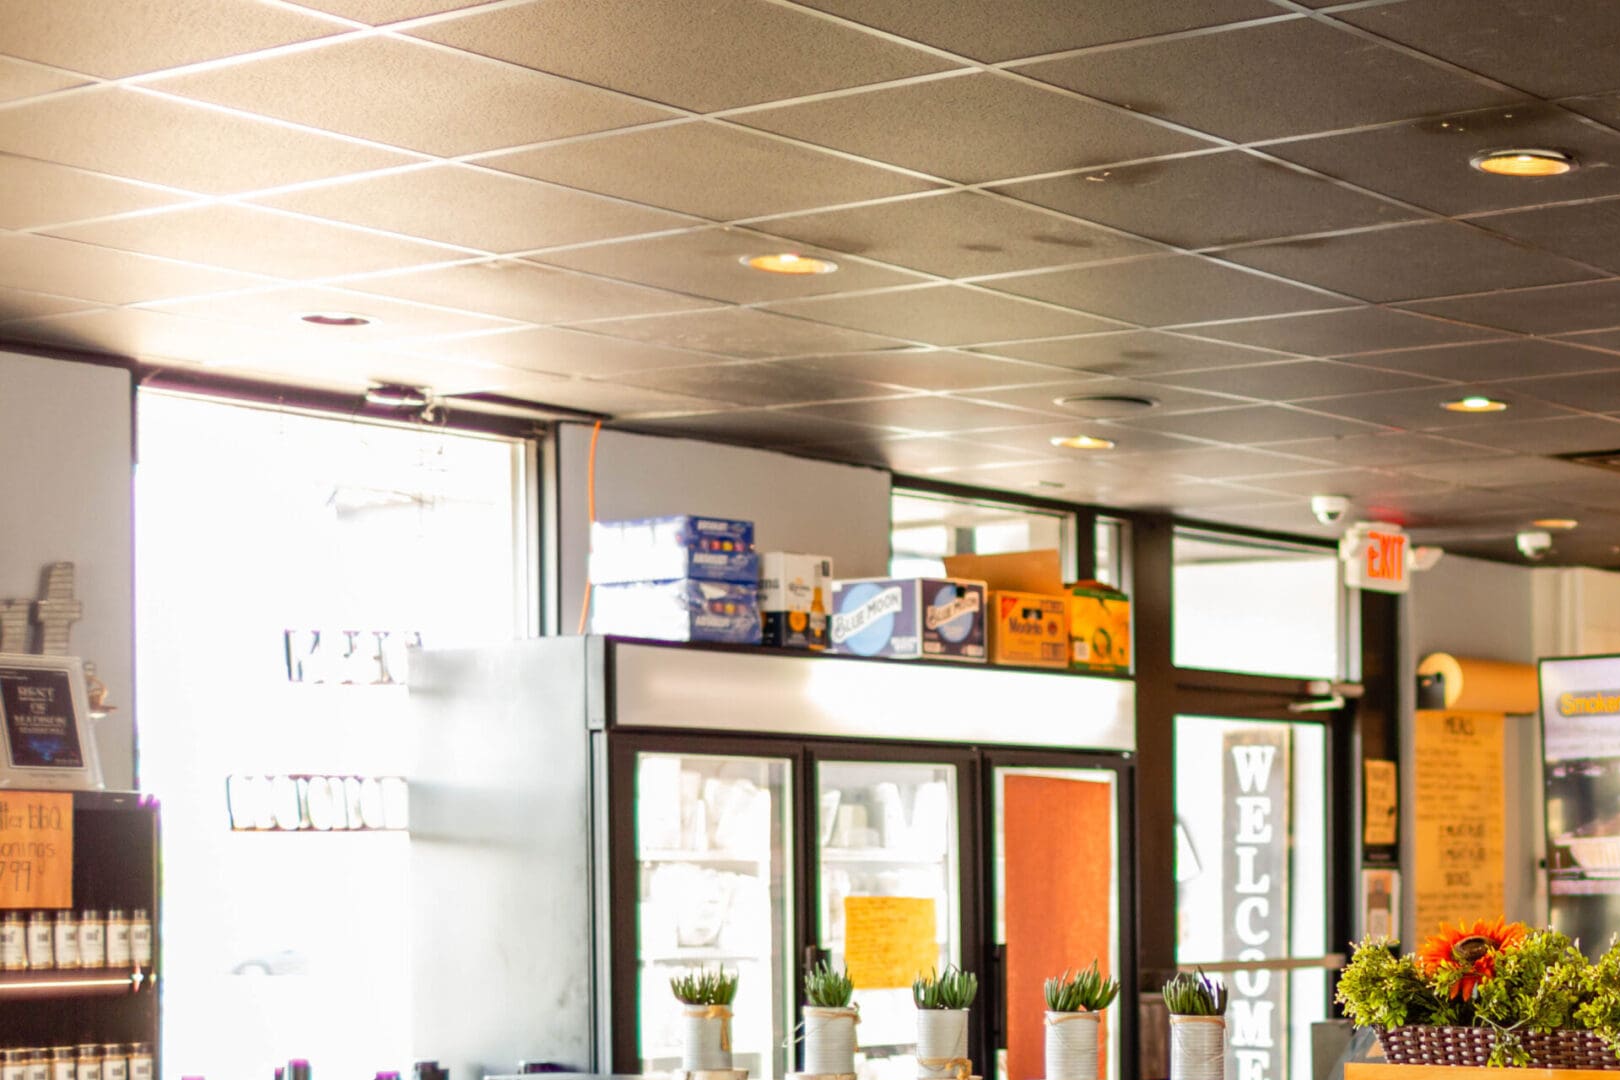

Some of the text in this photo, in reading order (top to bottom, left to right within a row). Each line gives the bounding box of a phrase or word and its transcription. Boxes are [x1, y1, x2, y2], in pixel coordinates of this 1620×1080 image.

[1368, 531, 1405, 581] EXIT
[834, 591, 899, 638] BLUE MOON
[28, 803, 62, 832] BBQ
